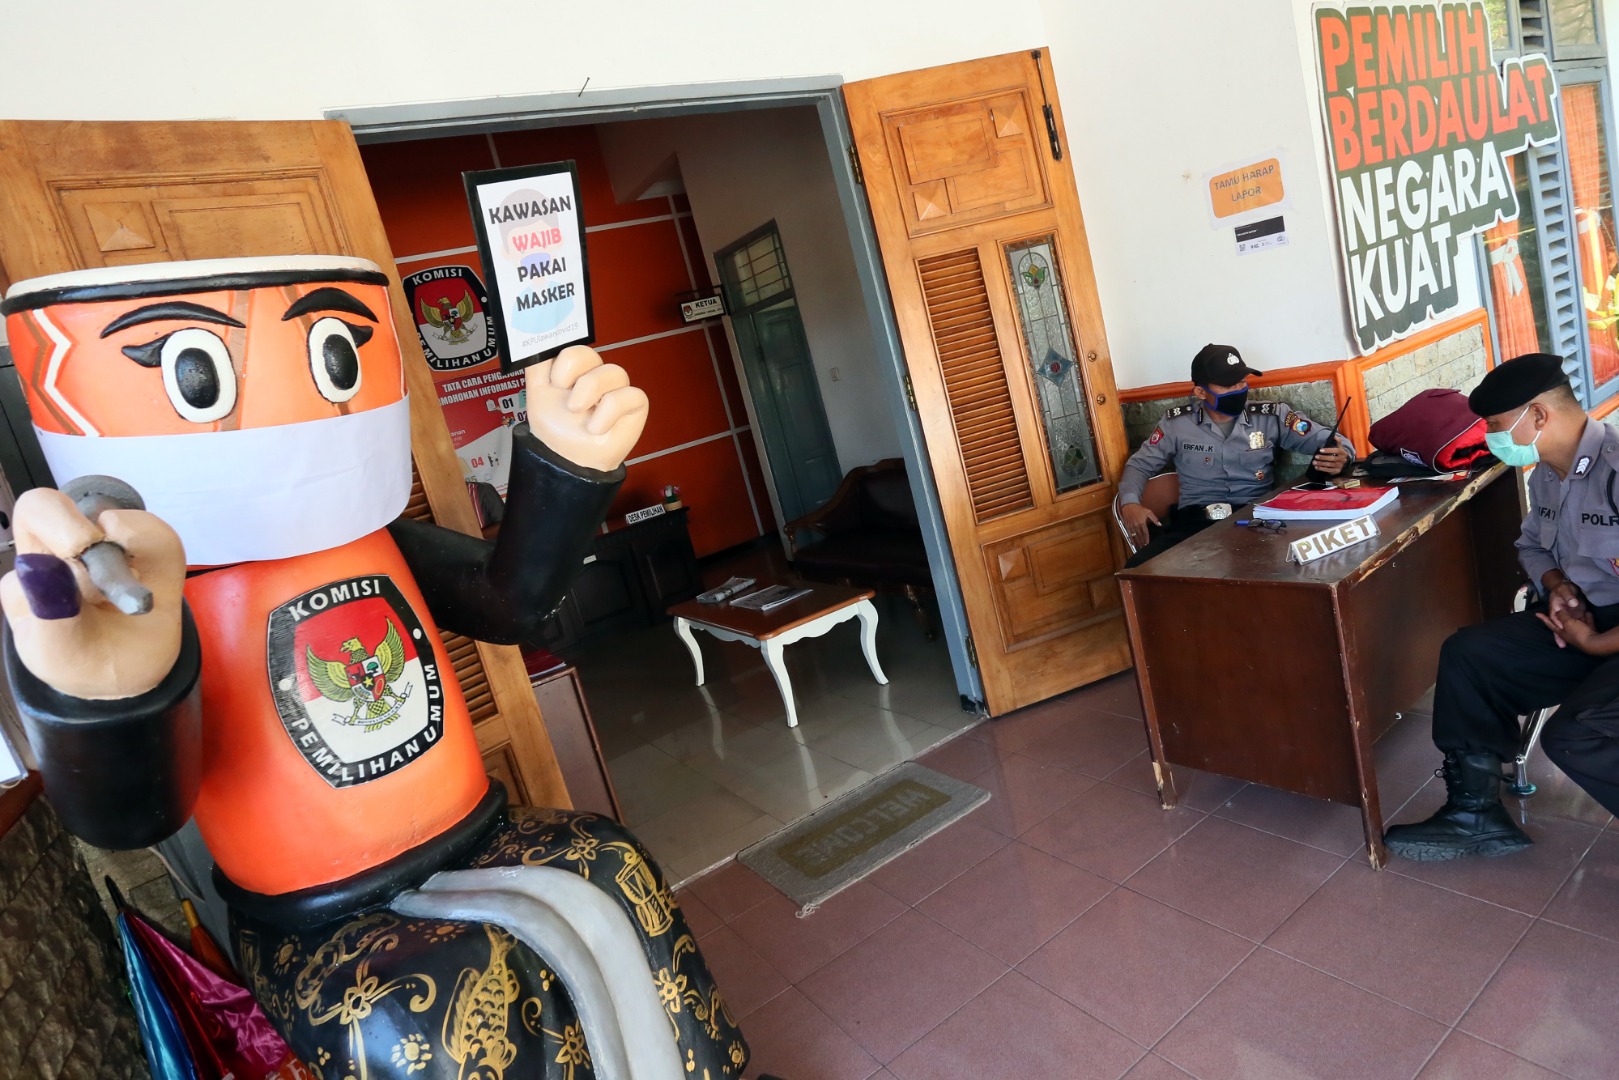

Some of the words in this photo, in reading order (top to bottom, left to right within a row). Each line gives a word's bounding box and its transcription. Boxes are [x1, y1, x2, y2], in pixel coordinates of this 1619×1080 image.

[1320, 8, 1487, 93] PEMILIH
[1328, 64, 1550, 171] BERDAULAT
[1214, 176, 1240, 190] TAMU
[1242, 165, 1274, 181] HARAP
[1231, 186, 1262, 202] LAPOR
[1340, 141, 1509, 251] NEGARA
[489, 195, 572, 224] KAWASAN
[512, 227, 562, 252] WAJIB
[412, 268, 463, 286] KOMISI
[517, 257, 567, 282] PAKAI
[1350, 222, 1452, 329] KUAT
[516, 282, 575, 312] MASKER
[694, 298, 718, 309] KETUA
[484, 316, 496, 357] UMUM
[442, 382, 462, 393] TATA
[461, 377, 483, 389] CARA
[479, 379, 520, 396] INFORMASI
[502, 397, 514, 409] 01
[471, 456, 484, 469] 04
[1296, 518, 1371, 561] PIKET
[288, 579, 381, 622] KOMISI
[292, 717, 421, 782] PEMILIHAN
[423, 663, 442, 743] UMUM
